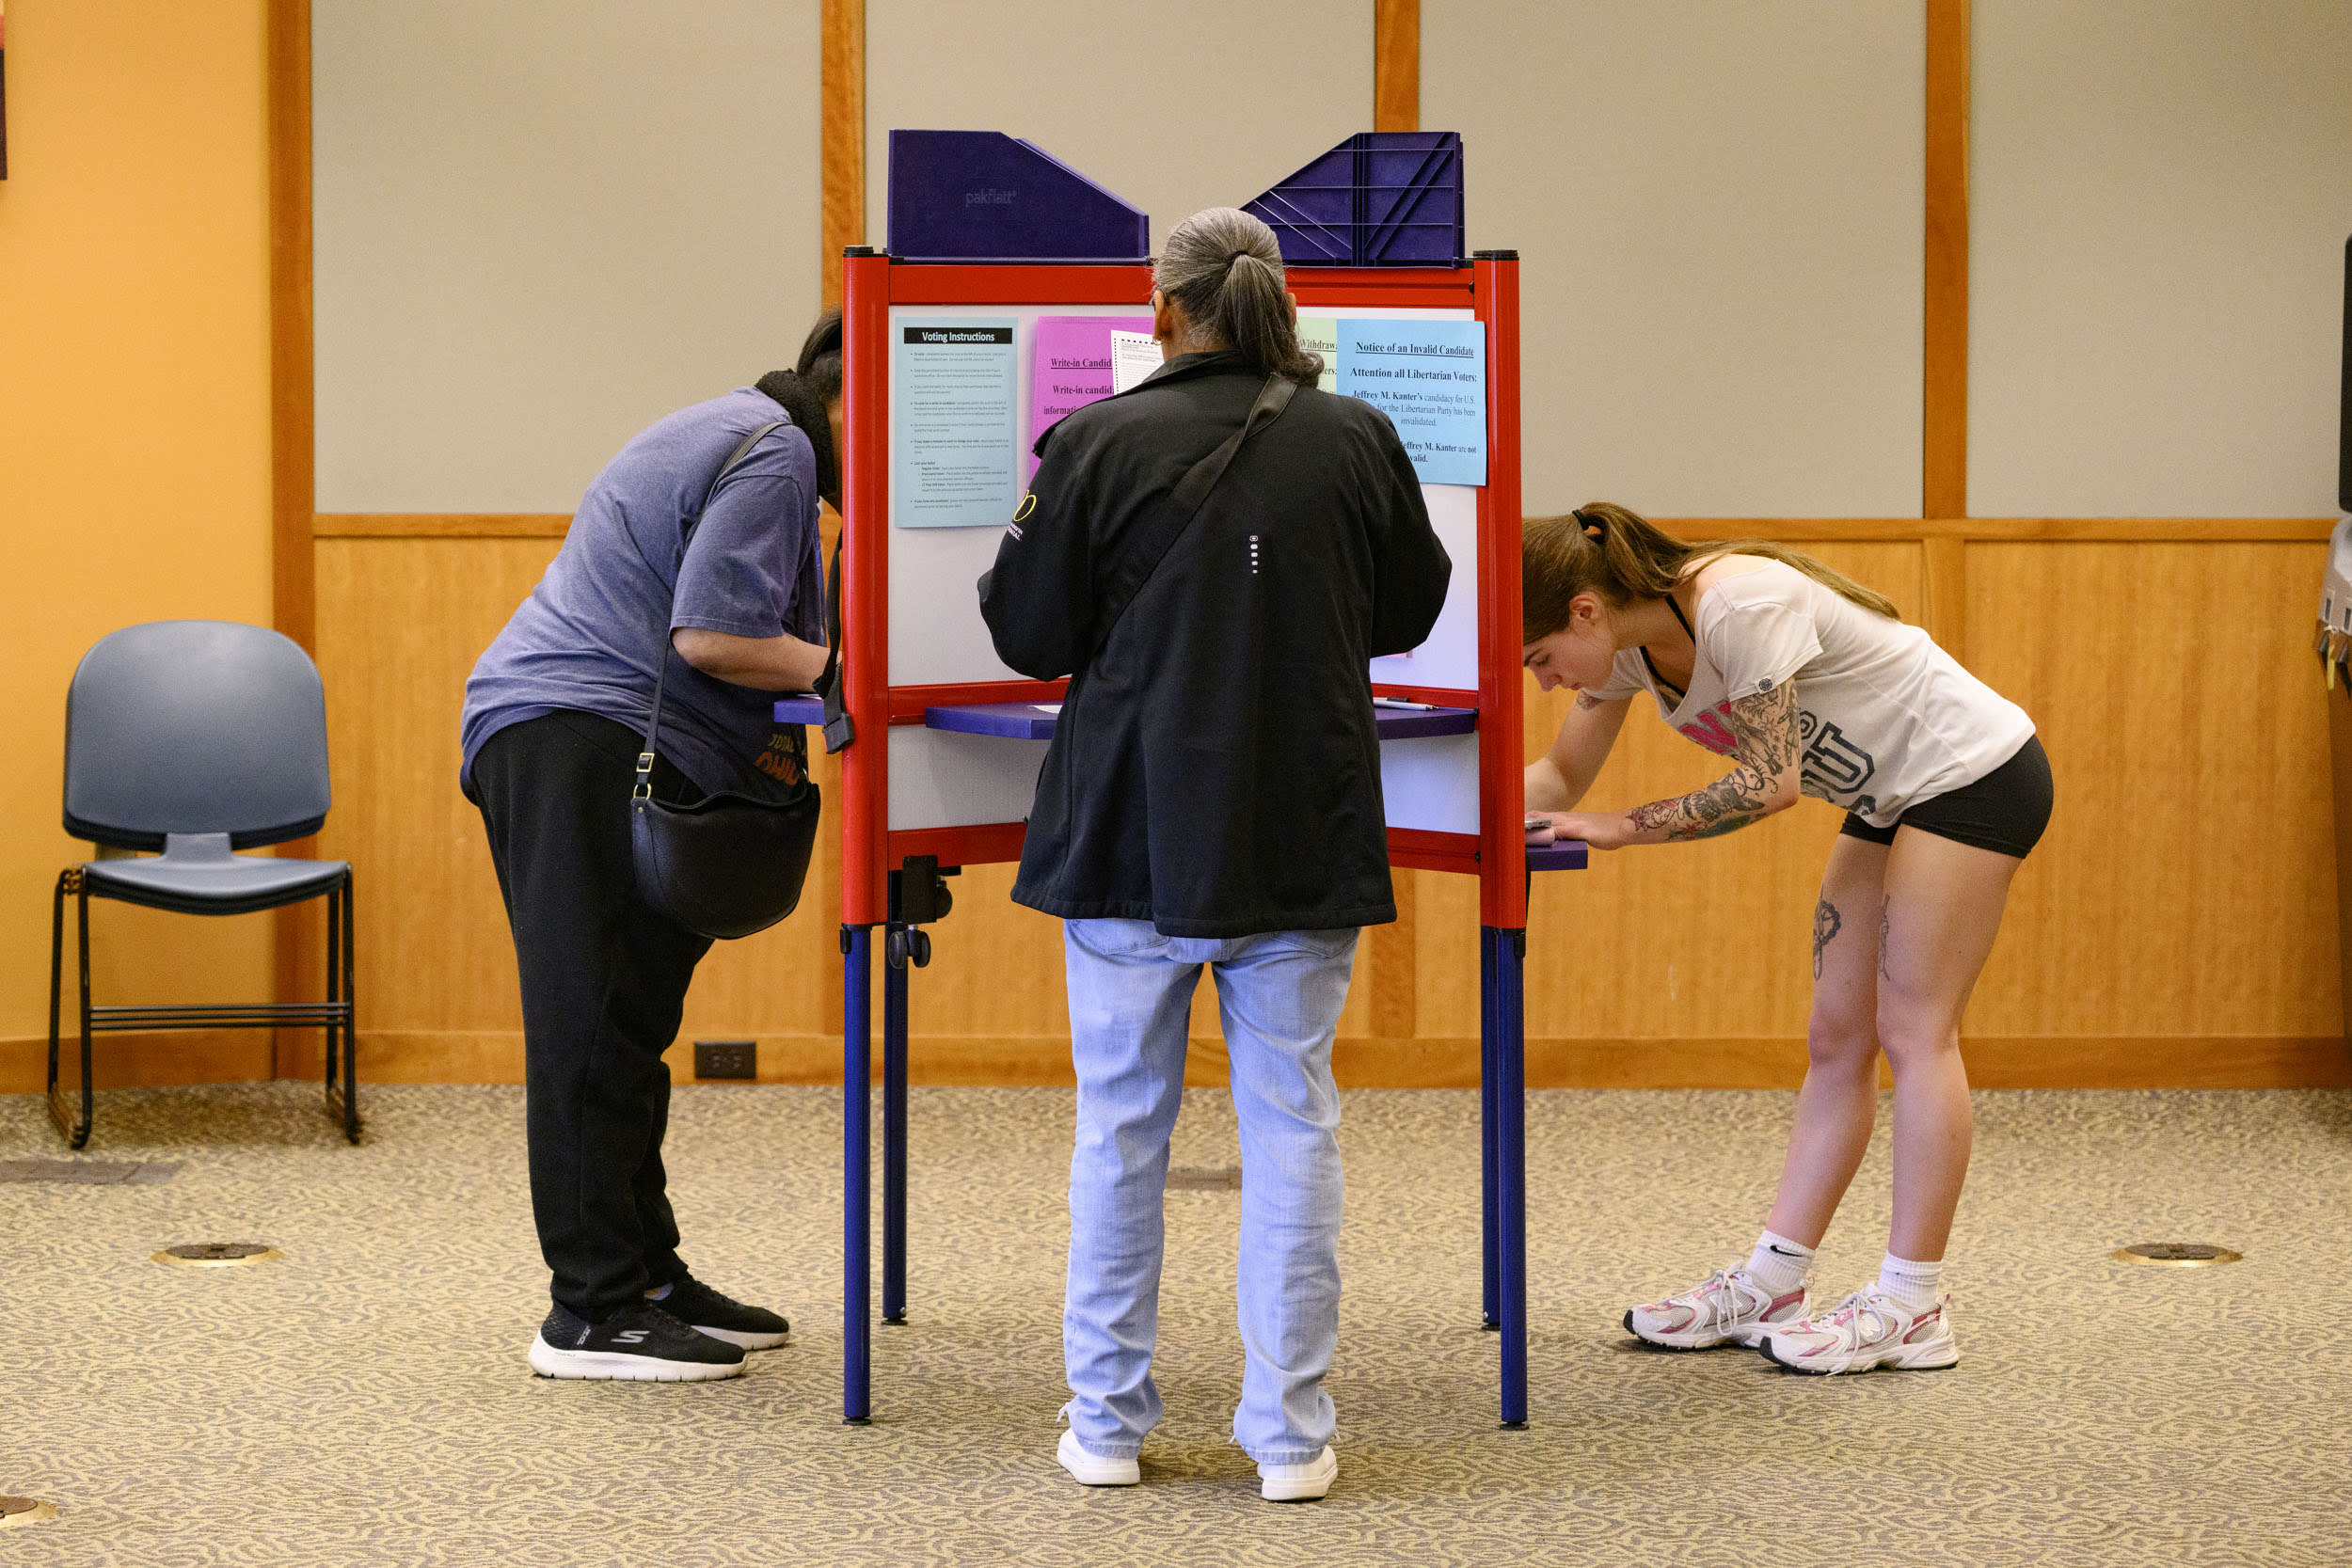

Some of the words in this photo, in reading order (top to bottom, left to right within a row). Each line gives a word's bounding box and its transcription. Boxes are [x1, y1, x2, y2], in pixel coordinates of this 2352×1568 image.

[922, 332, 947, 342] Voting
[949, 332, 995, 341] Instructions
[1356, 342, 1384, 352] Notice
[1387, 342, 1395, 353] of
[1410, 344, 1437, 355] Invalid
[1439, 345, 1474, 356] Candidate
[1051, 358, 1080, 367] Write-in
[1350, 368, 1391, 378] Attention
[1394, 370, 1405, 378] all
[1407, 370, 1452, 380] Libertarian
[1454, 372, 1477, 382] Voters:
[1053, 386, 1083, 394] Write-in
[1381, 391, 1391, 400] M.
[1424, 394, 1454, 404] candidacy
[1401, 404, 1435, 414] Libertarian
[1438, 406, 1452, 416] Party
[1424, 442, 1434, 451] M.
[1436, 443, 1456, 452] Kanter
